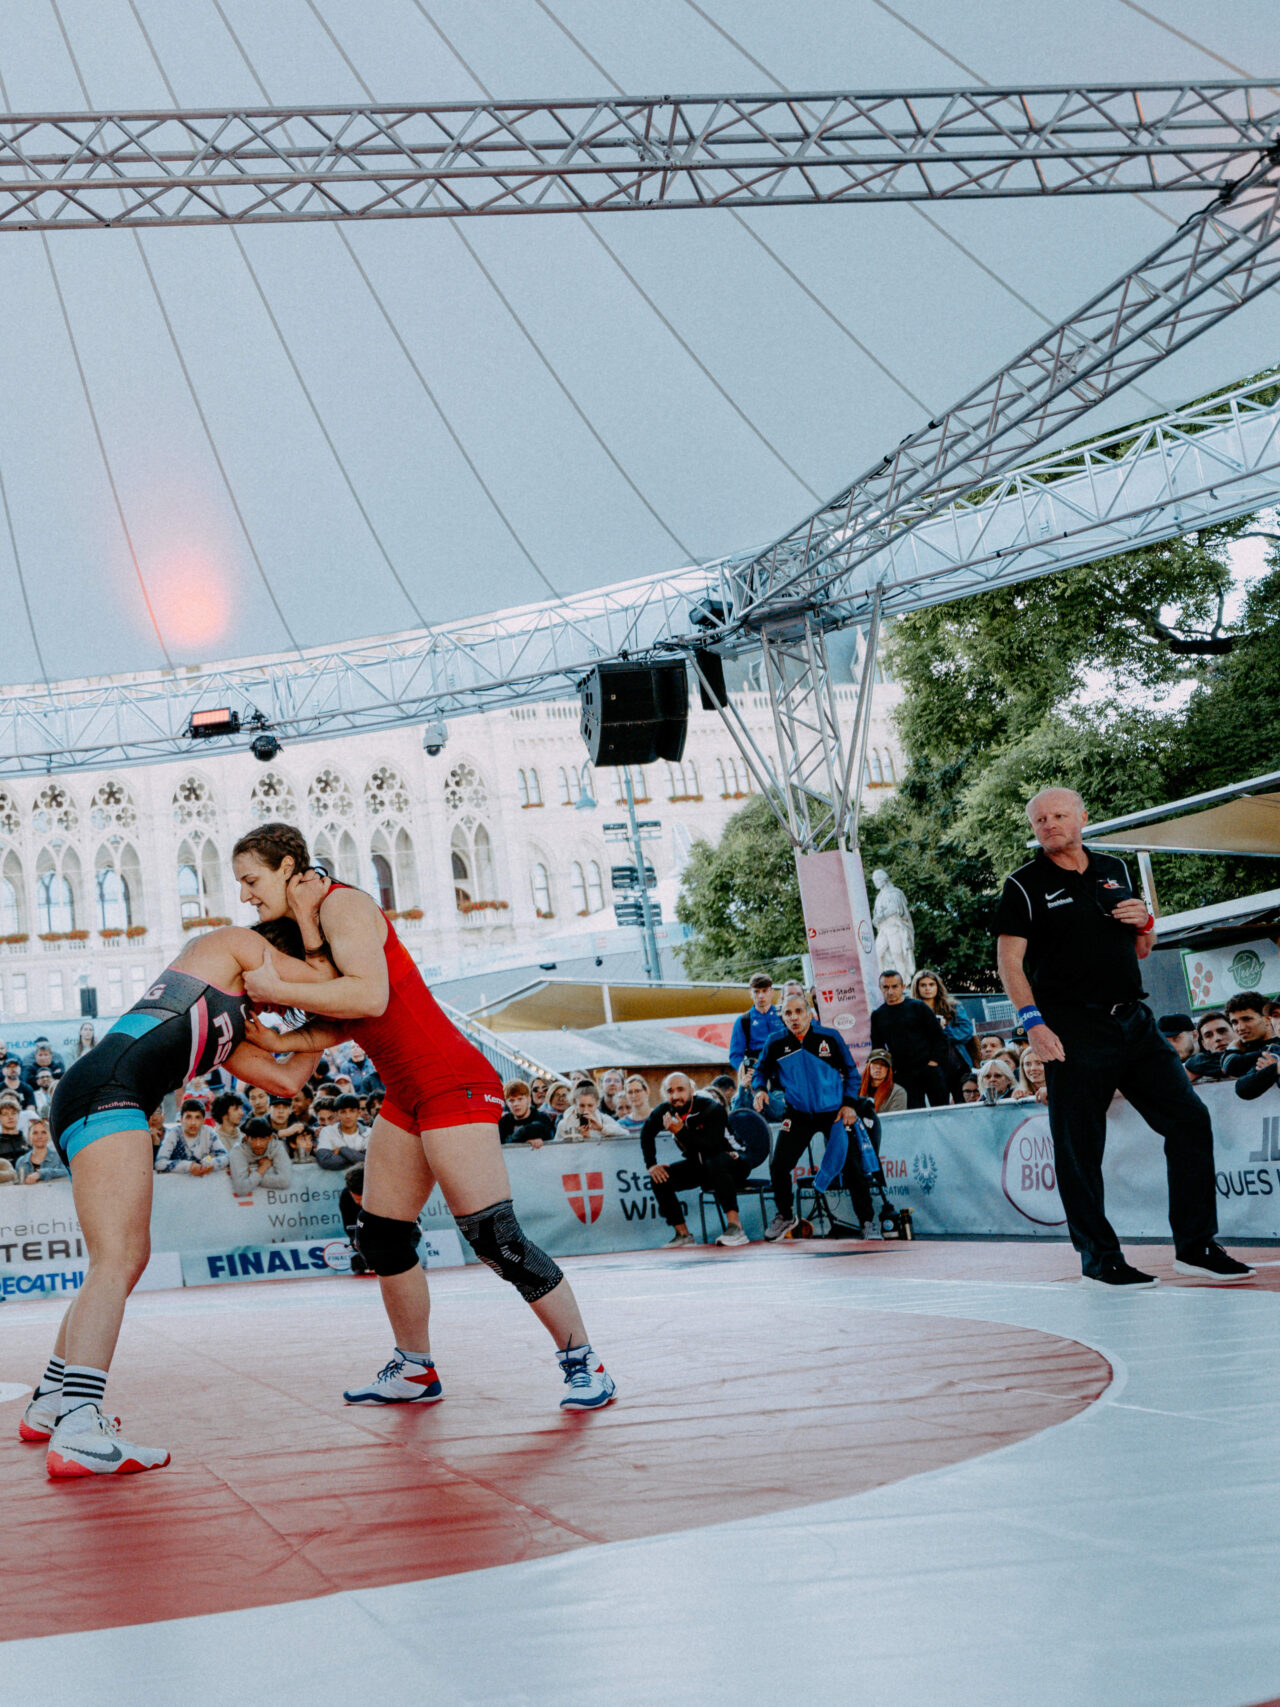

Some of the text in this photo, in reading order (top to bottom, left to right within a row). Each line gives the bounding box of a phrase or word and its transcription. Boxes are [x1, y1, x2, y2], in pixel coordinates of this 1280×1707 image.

[616, 1170, 652, 1193] Sta
[1021, 1163, 1056, 1191] BiO
[1216, 1169, 1273, 1199] QUES
[208, 1247, 329, 1278] FINALS
